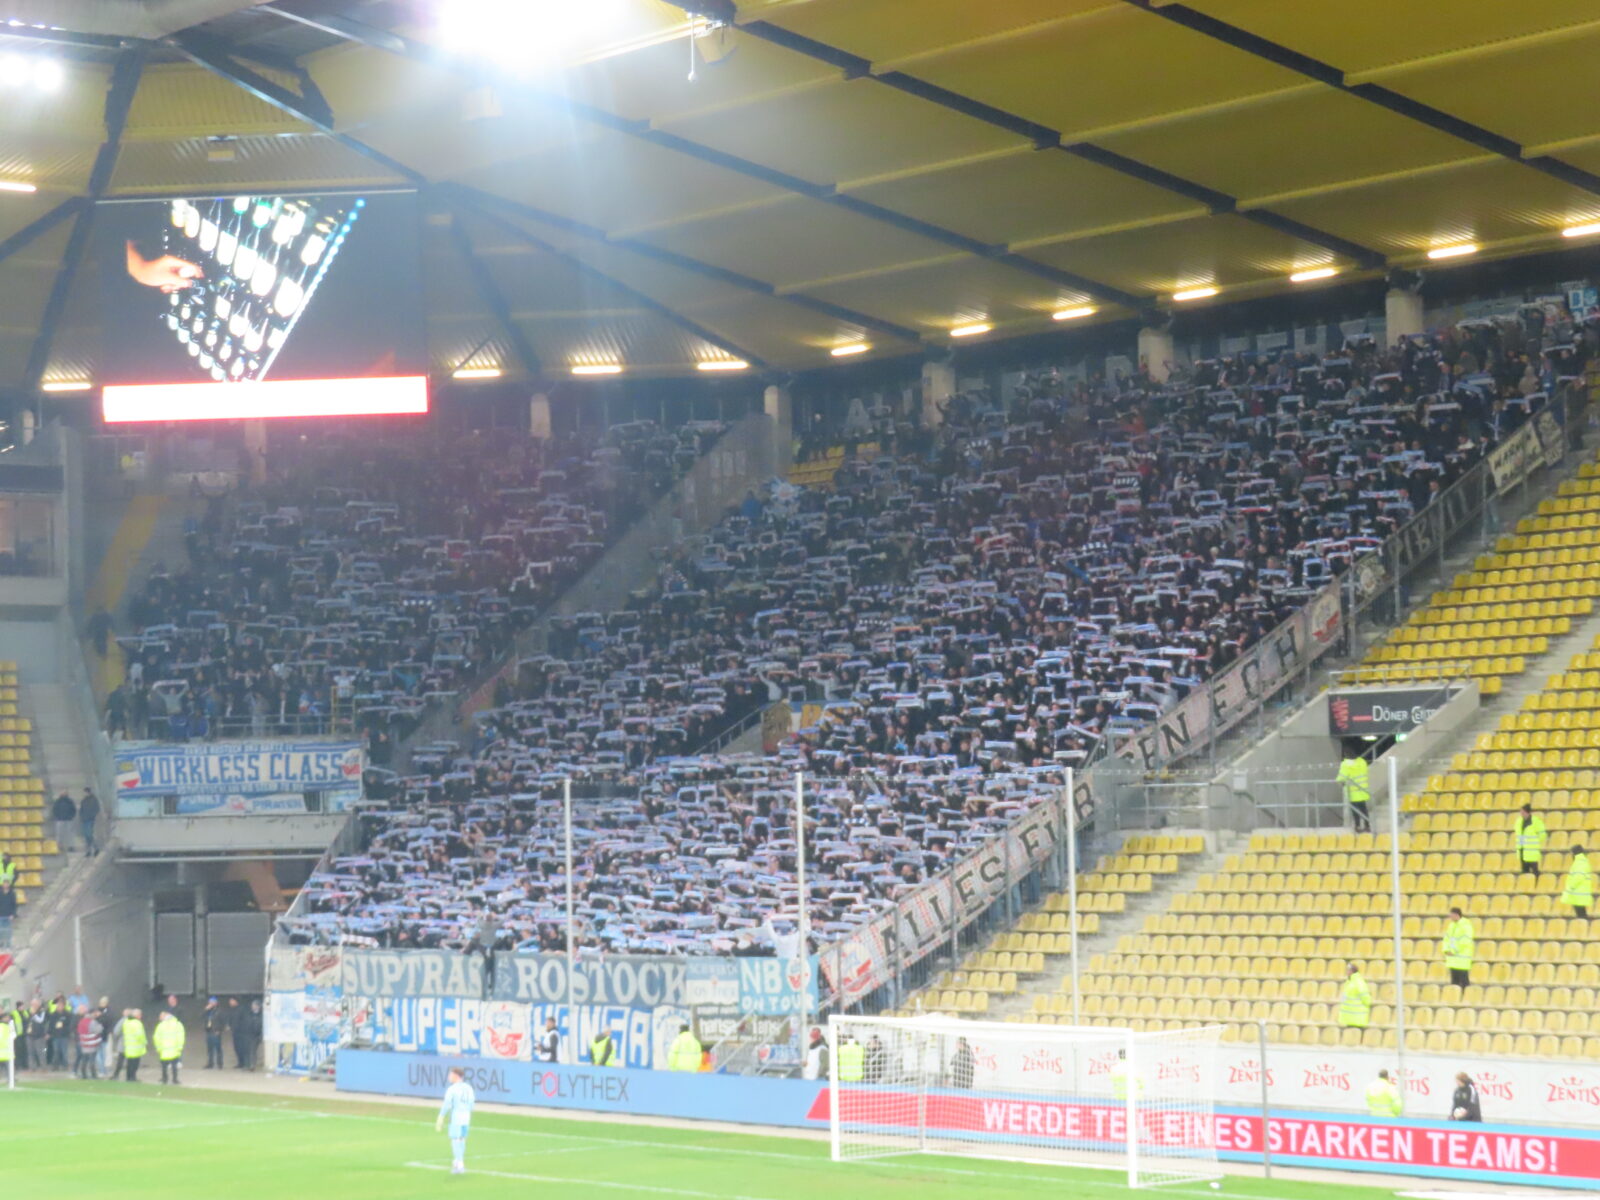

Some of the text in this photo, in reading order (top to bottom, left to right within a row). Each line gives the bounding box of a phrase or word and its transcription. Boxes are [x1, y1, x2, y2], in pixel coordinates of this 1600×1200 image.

[136, 753, 344, 785] WORKLESS CLASS
[343, 953, 484, 997] SUPTRAS
[514, 957, 686, 1004] ROSTOCK
[740, 958, 782, 994] NB
[373, 998, 482, 1054] SUPER
[407, 1063, 630, 1101] UNIVRSAL POLYTHEX
[1228, 1065, 1274, 1086] ZENTS
[1303, 1068, 1351, 1091] ZENTIS
[1473, 1080, 1514, 1101] ENTIS
[1547, 1082, 1600, 1106] ZENTIS
[983, 1101, 1558, 1173] WERDE TEL EINES STARKEN TEAMS!
